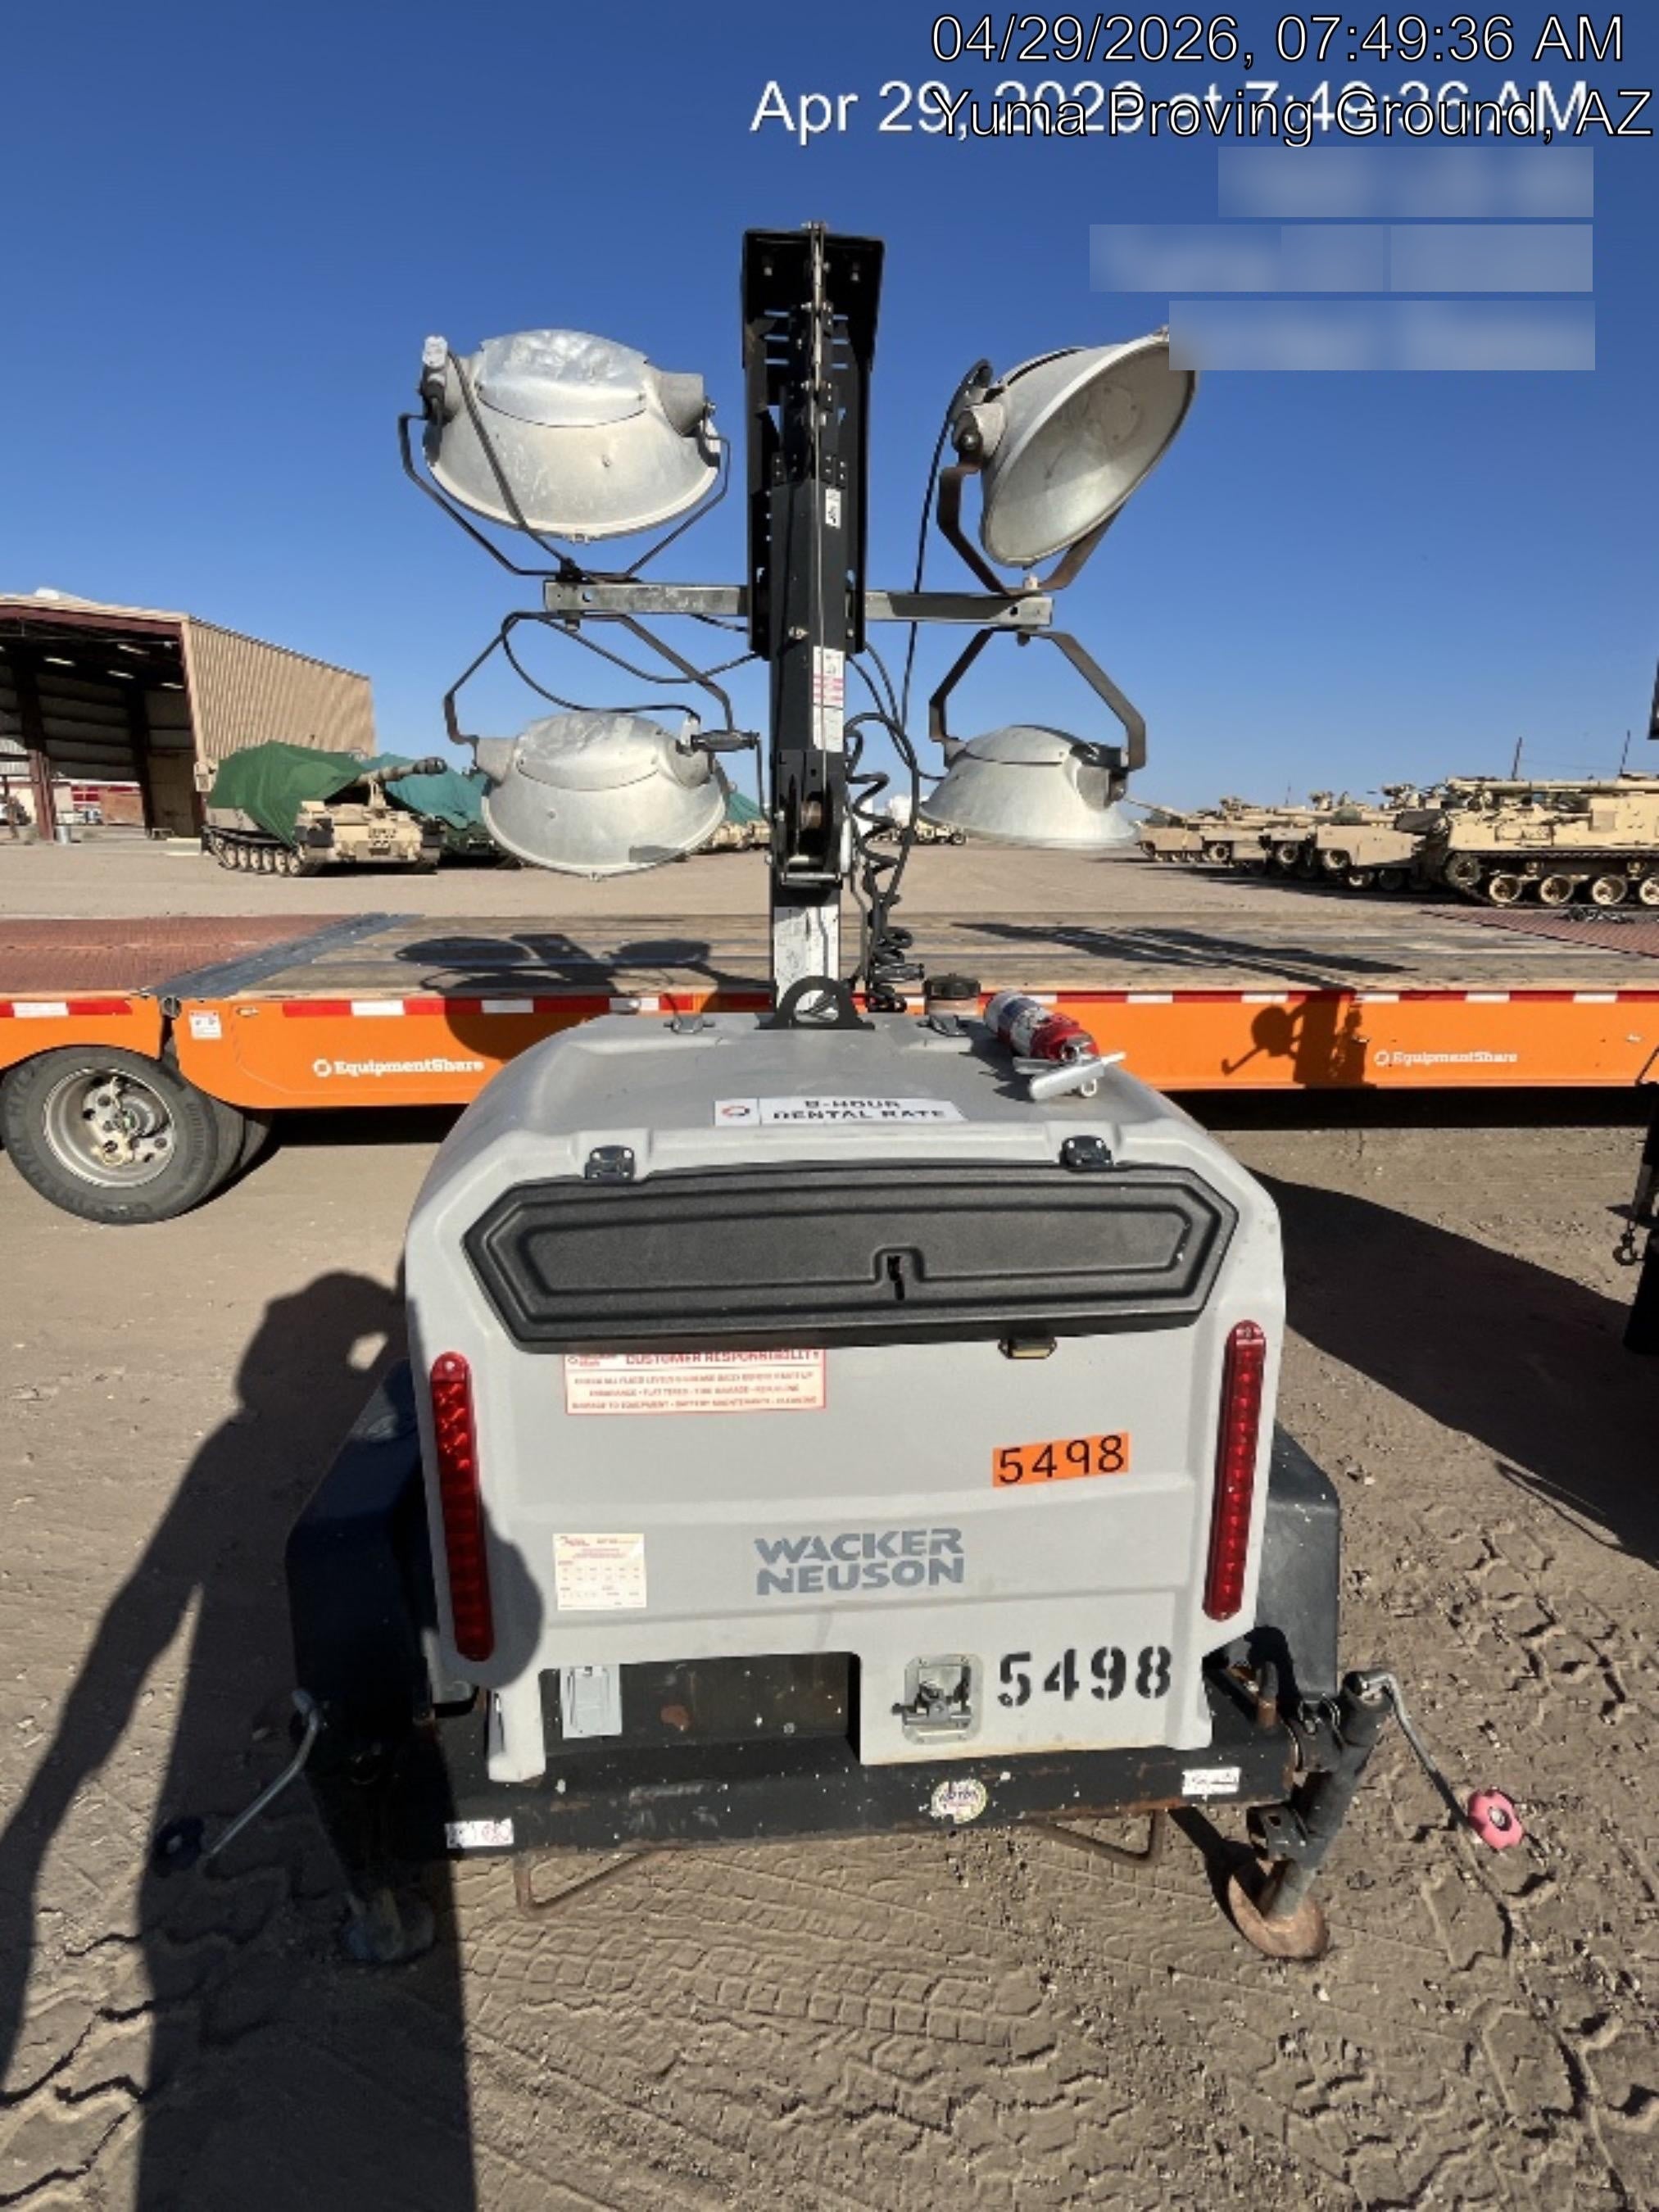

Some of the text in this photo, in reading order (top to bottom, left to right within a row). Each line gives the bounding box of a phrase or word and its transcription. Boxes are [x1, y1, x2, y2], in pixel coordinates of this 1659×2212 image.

[334, 1058, 484, 1077] EquipmentShare
[1392, 1051, 1518, 1067] EquipmentShare
[999, 1435, 1124, 1484] 5498
[754, 1528, 964, 1564] WACKER
[756, 1557, 964, 1596] NEUSON
[997, 1646, 1172, 1708] 5498
